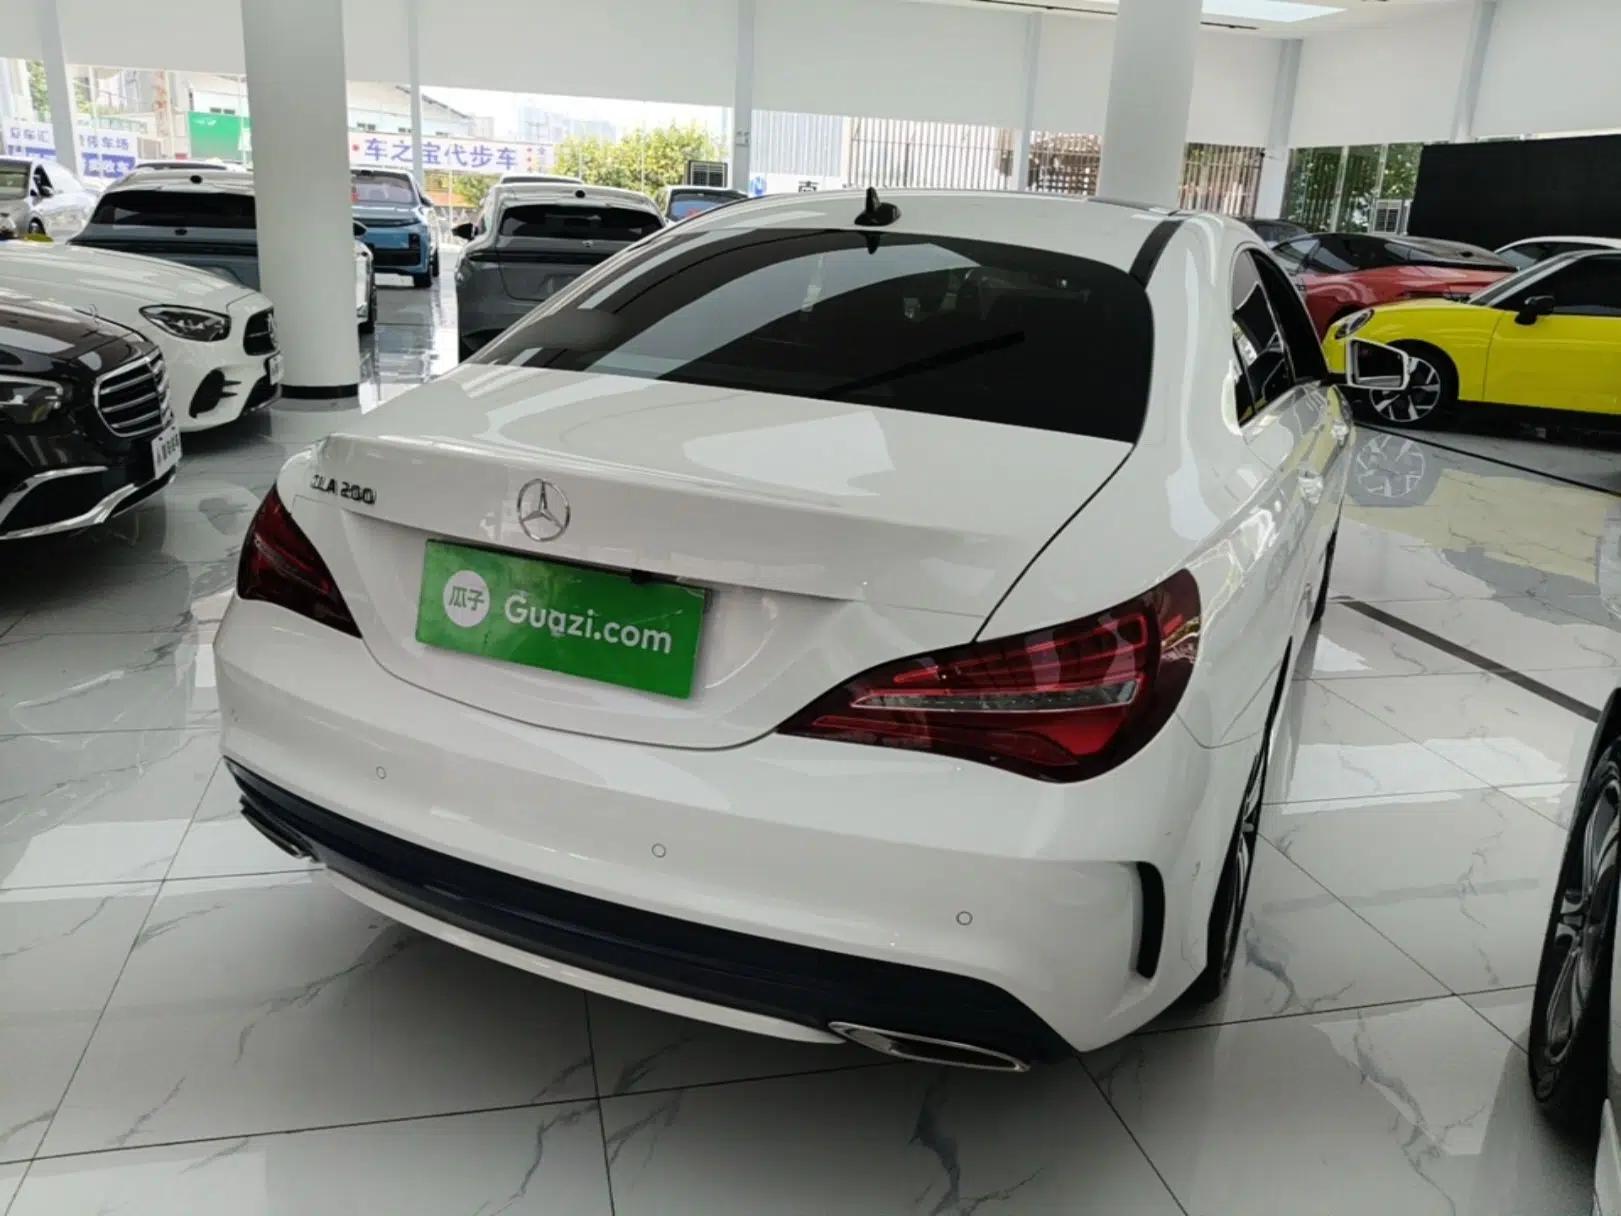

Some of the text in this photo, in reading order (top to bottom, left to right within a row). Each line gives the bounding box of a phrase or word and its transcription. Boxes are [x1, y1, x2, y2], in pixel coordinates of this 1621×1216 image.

[364, 137, 518, 171] 车之宝代步车
[340, 481, 376, 505] 200
[448, 586, 485, 611] 瓜子
[504, 594, 672, 653] Guazi.com
